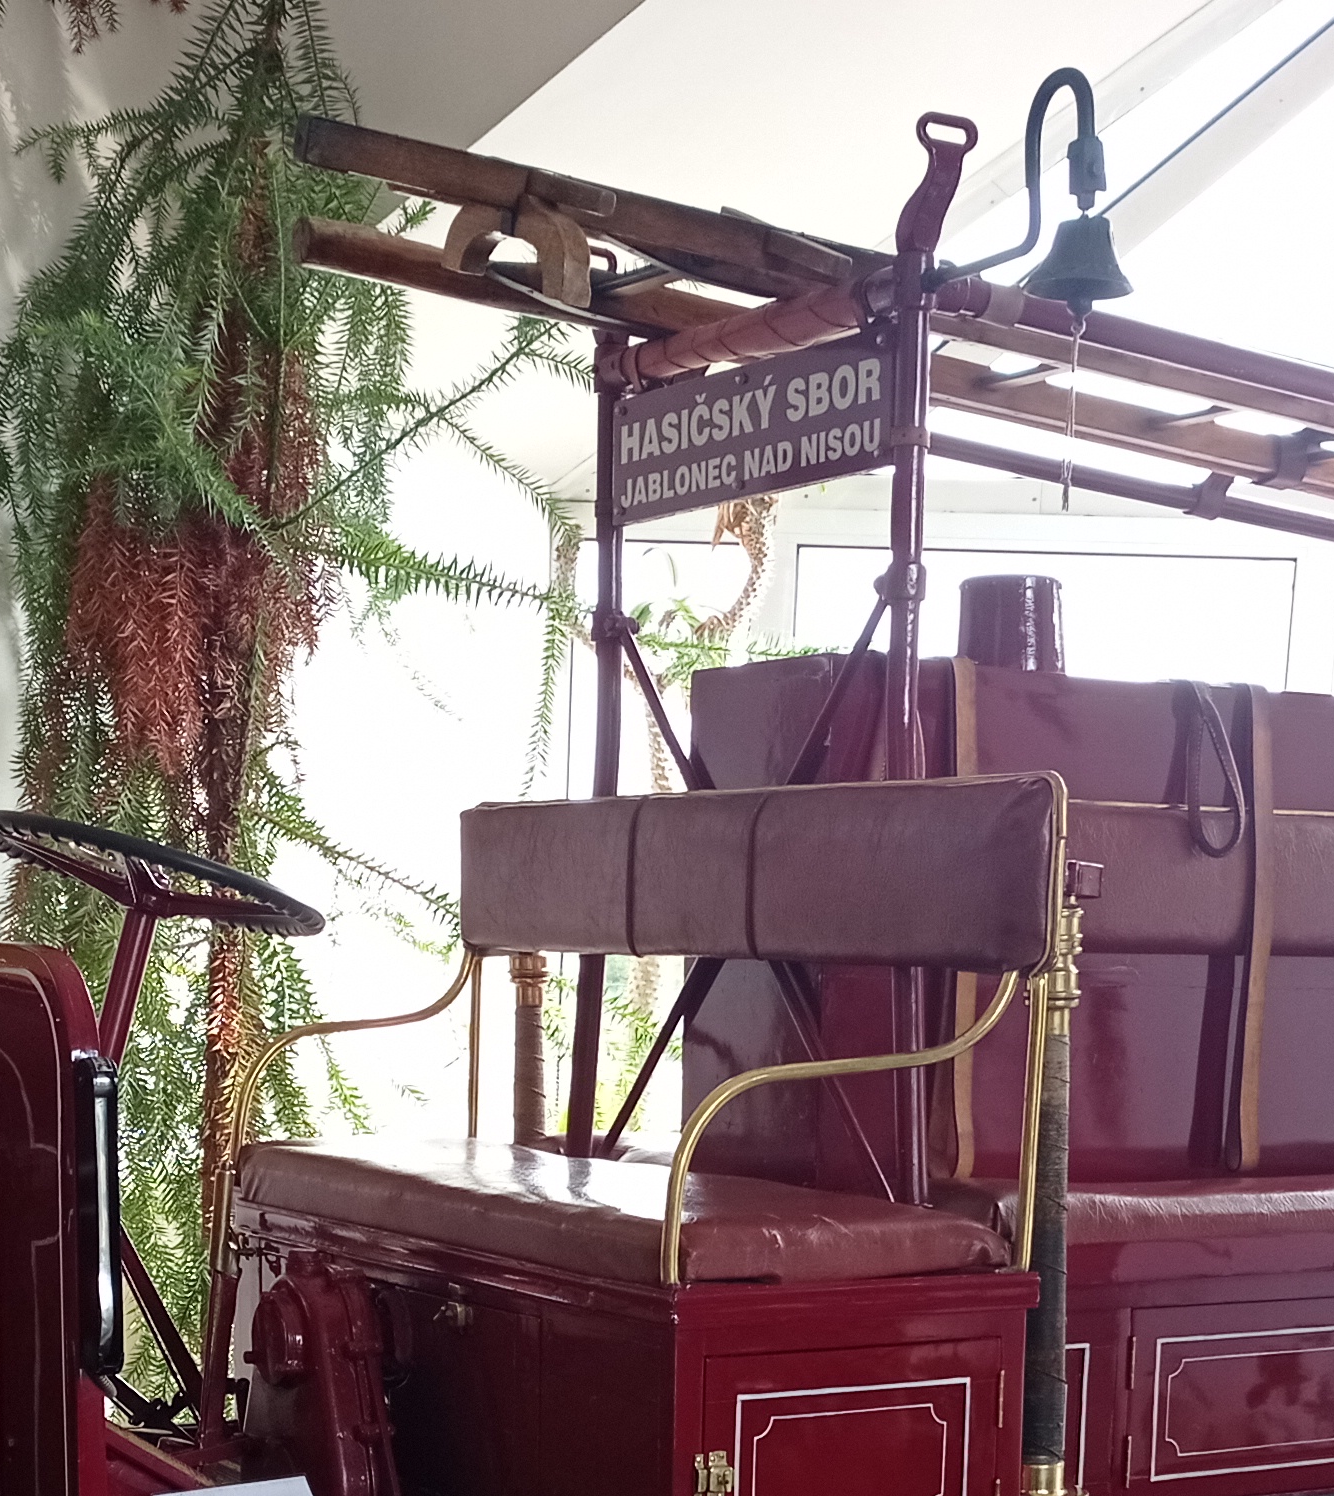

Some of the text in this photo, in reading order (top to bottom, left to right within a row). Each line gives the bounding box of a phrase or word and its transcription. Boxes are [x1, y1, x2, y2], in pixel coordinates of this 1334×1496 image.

[620, 358, 882, 466] HASIČSKÝ SBOR
[621, 418, 882, 509] JABLONEC NAD NISOU
